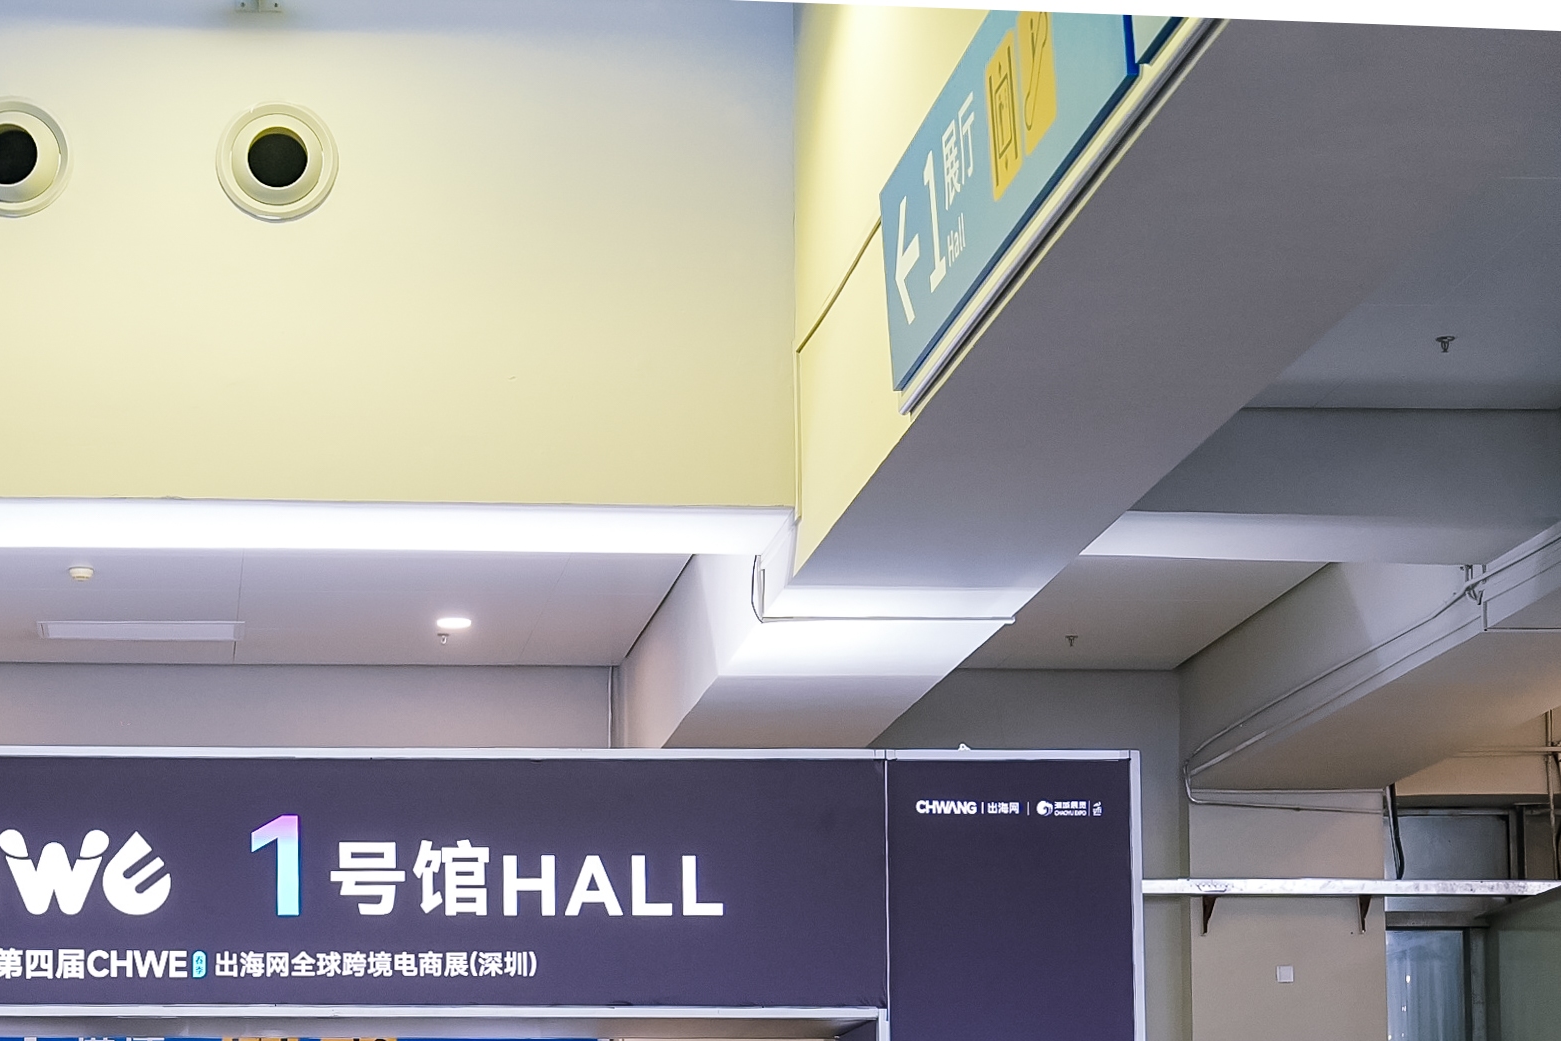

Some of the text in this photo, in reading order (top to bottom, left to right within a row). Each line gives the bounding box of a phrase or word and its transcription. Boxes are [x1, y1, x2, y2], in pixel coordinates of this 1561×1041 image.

[941, 91, 975, 211] 展厅
[922, 149, 946, 293] 1
[946, 212, 966, 268] Hall
[916, 800, 1020, 814] CHWANG 出海网
[215, 950, 537, 978] 出海网全球跨境电商展(深圳)
